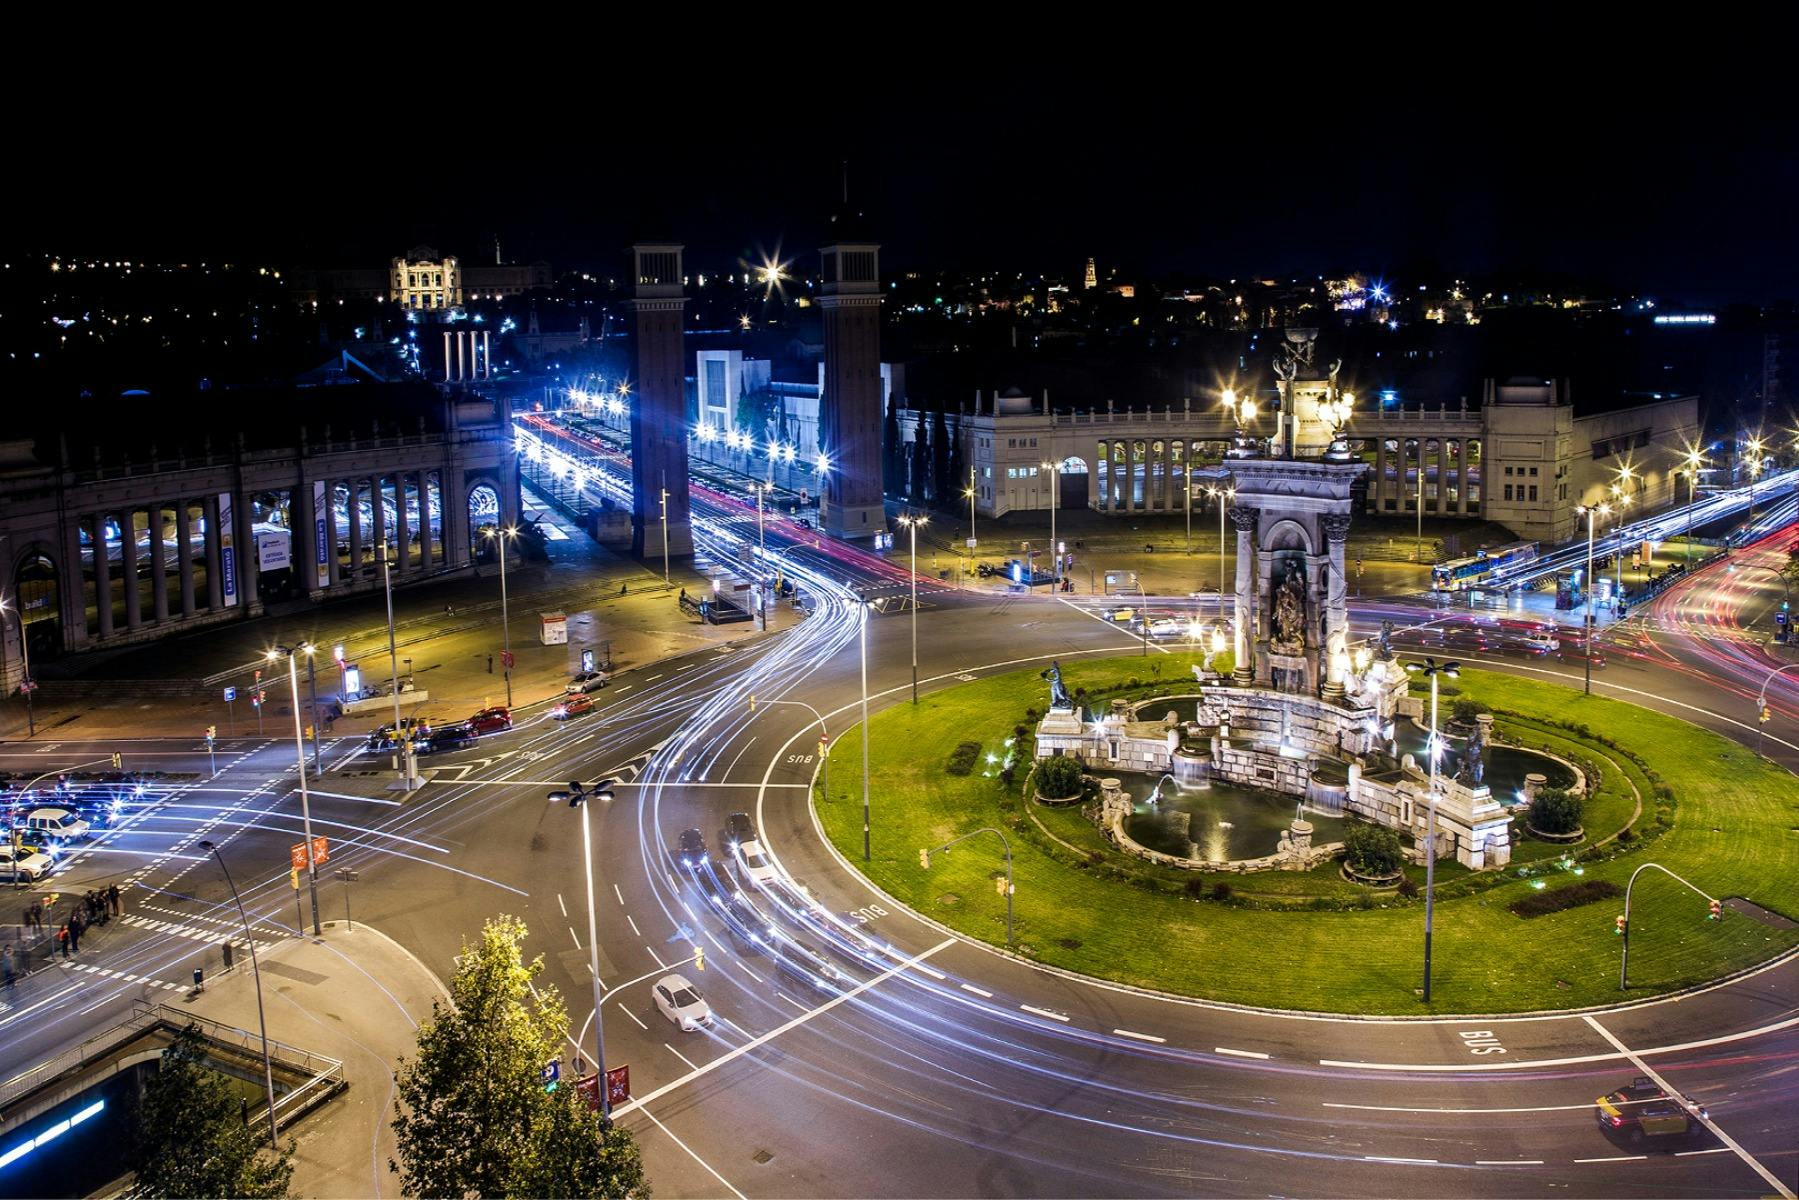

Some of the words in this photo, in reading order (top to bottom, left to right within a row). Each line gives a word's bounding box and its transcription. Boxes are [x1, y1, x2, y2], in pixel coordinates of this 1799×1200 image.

[787, 754, 813, 763] BUS
[850, 904, 888, 923] BUS
[1459, 1031, 1507, 1055] BUS
